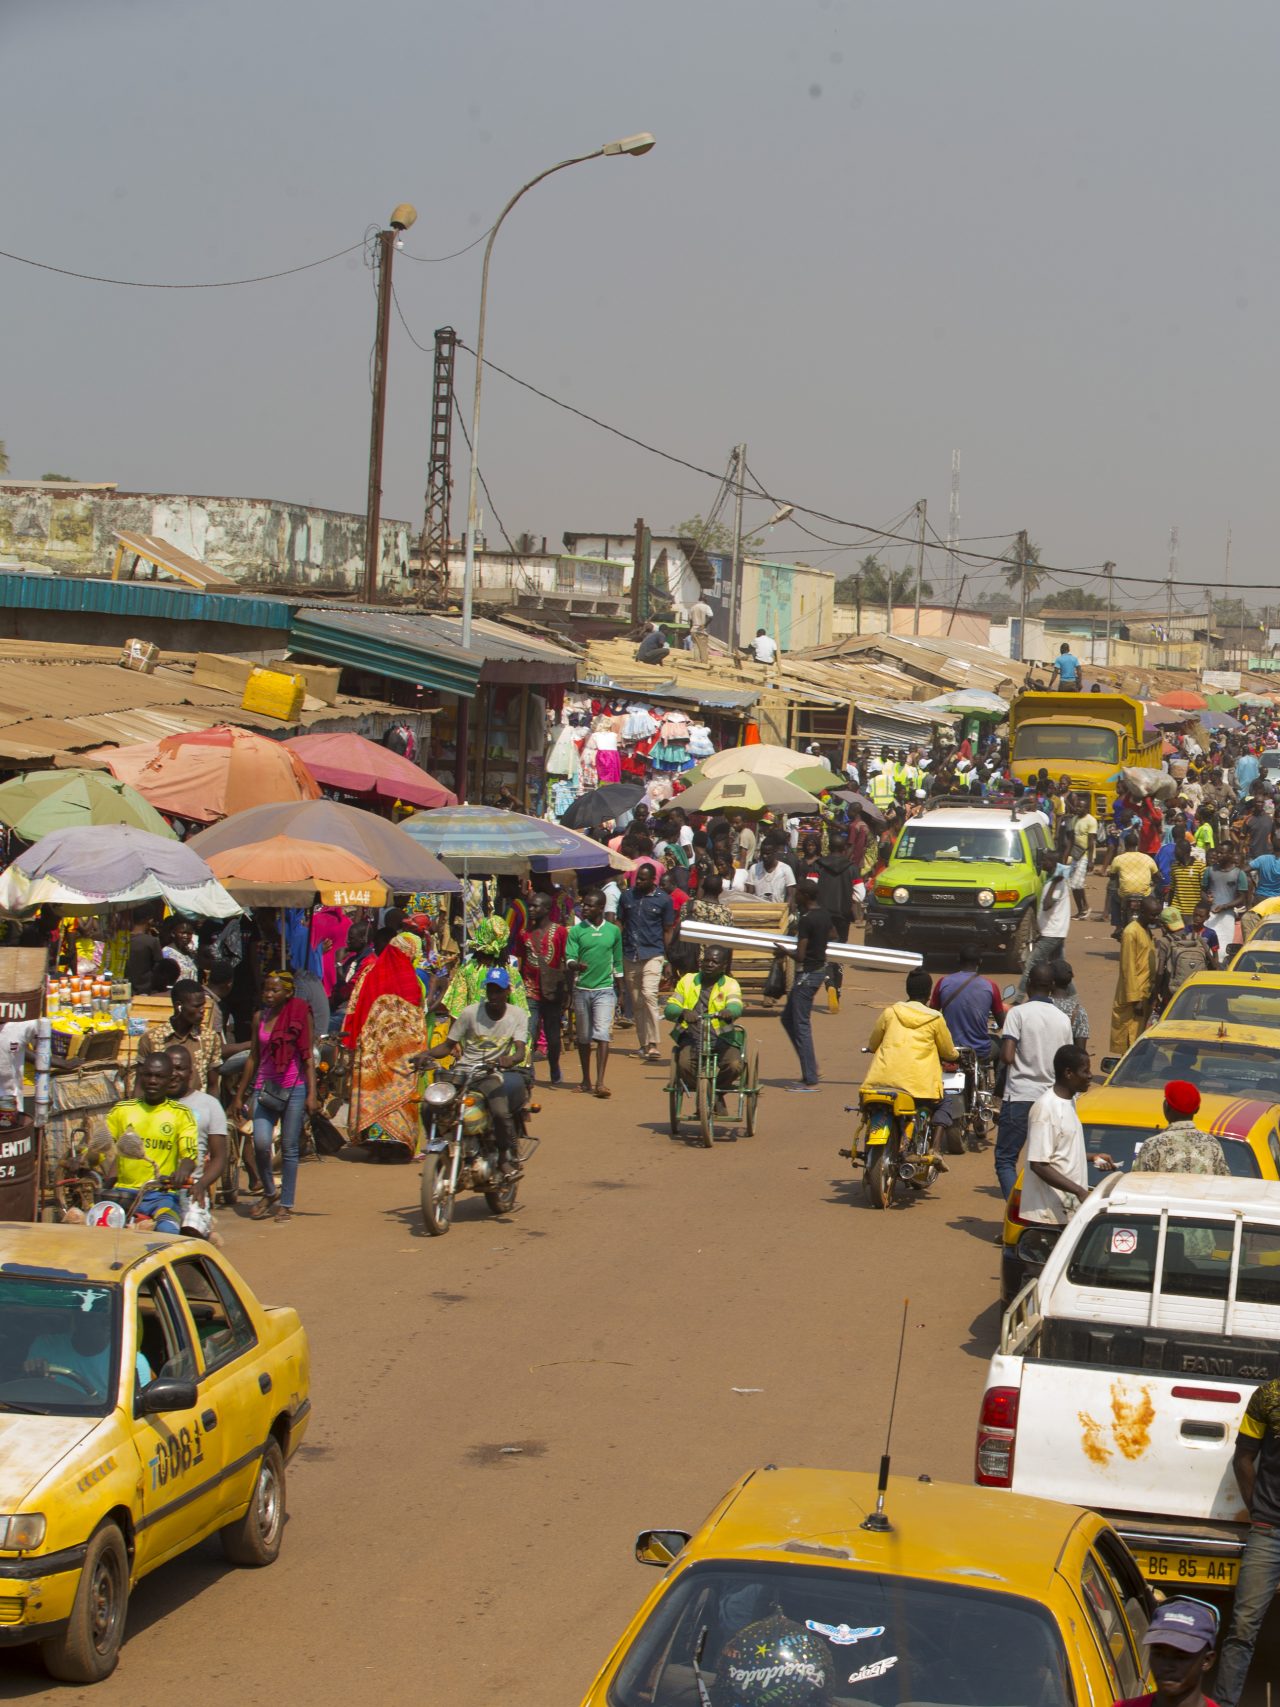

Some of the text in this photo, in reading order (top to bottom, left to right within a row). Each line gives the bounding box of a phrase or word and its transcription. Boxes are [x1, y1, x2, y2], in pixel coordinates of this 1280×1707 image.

[333, 889, 371, 905] #144#
[140, 1137, 173, 1151] SUNG
[1149, 1556, 1236, 1580] BG 85 AAT
